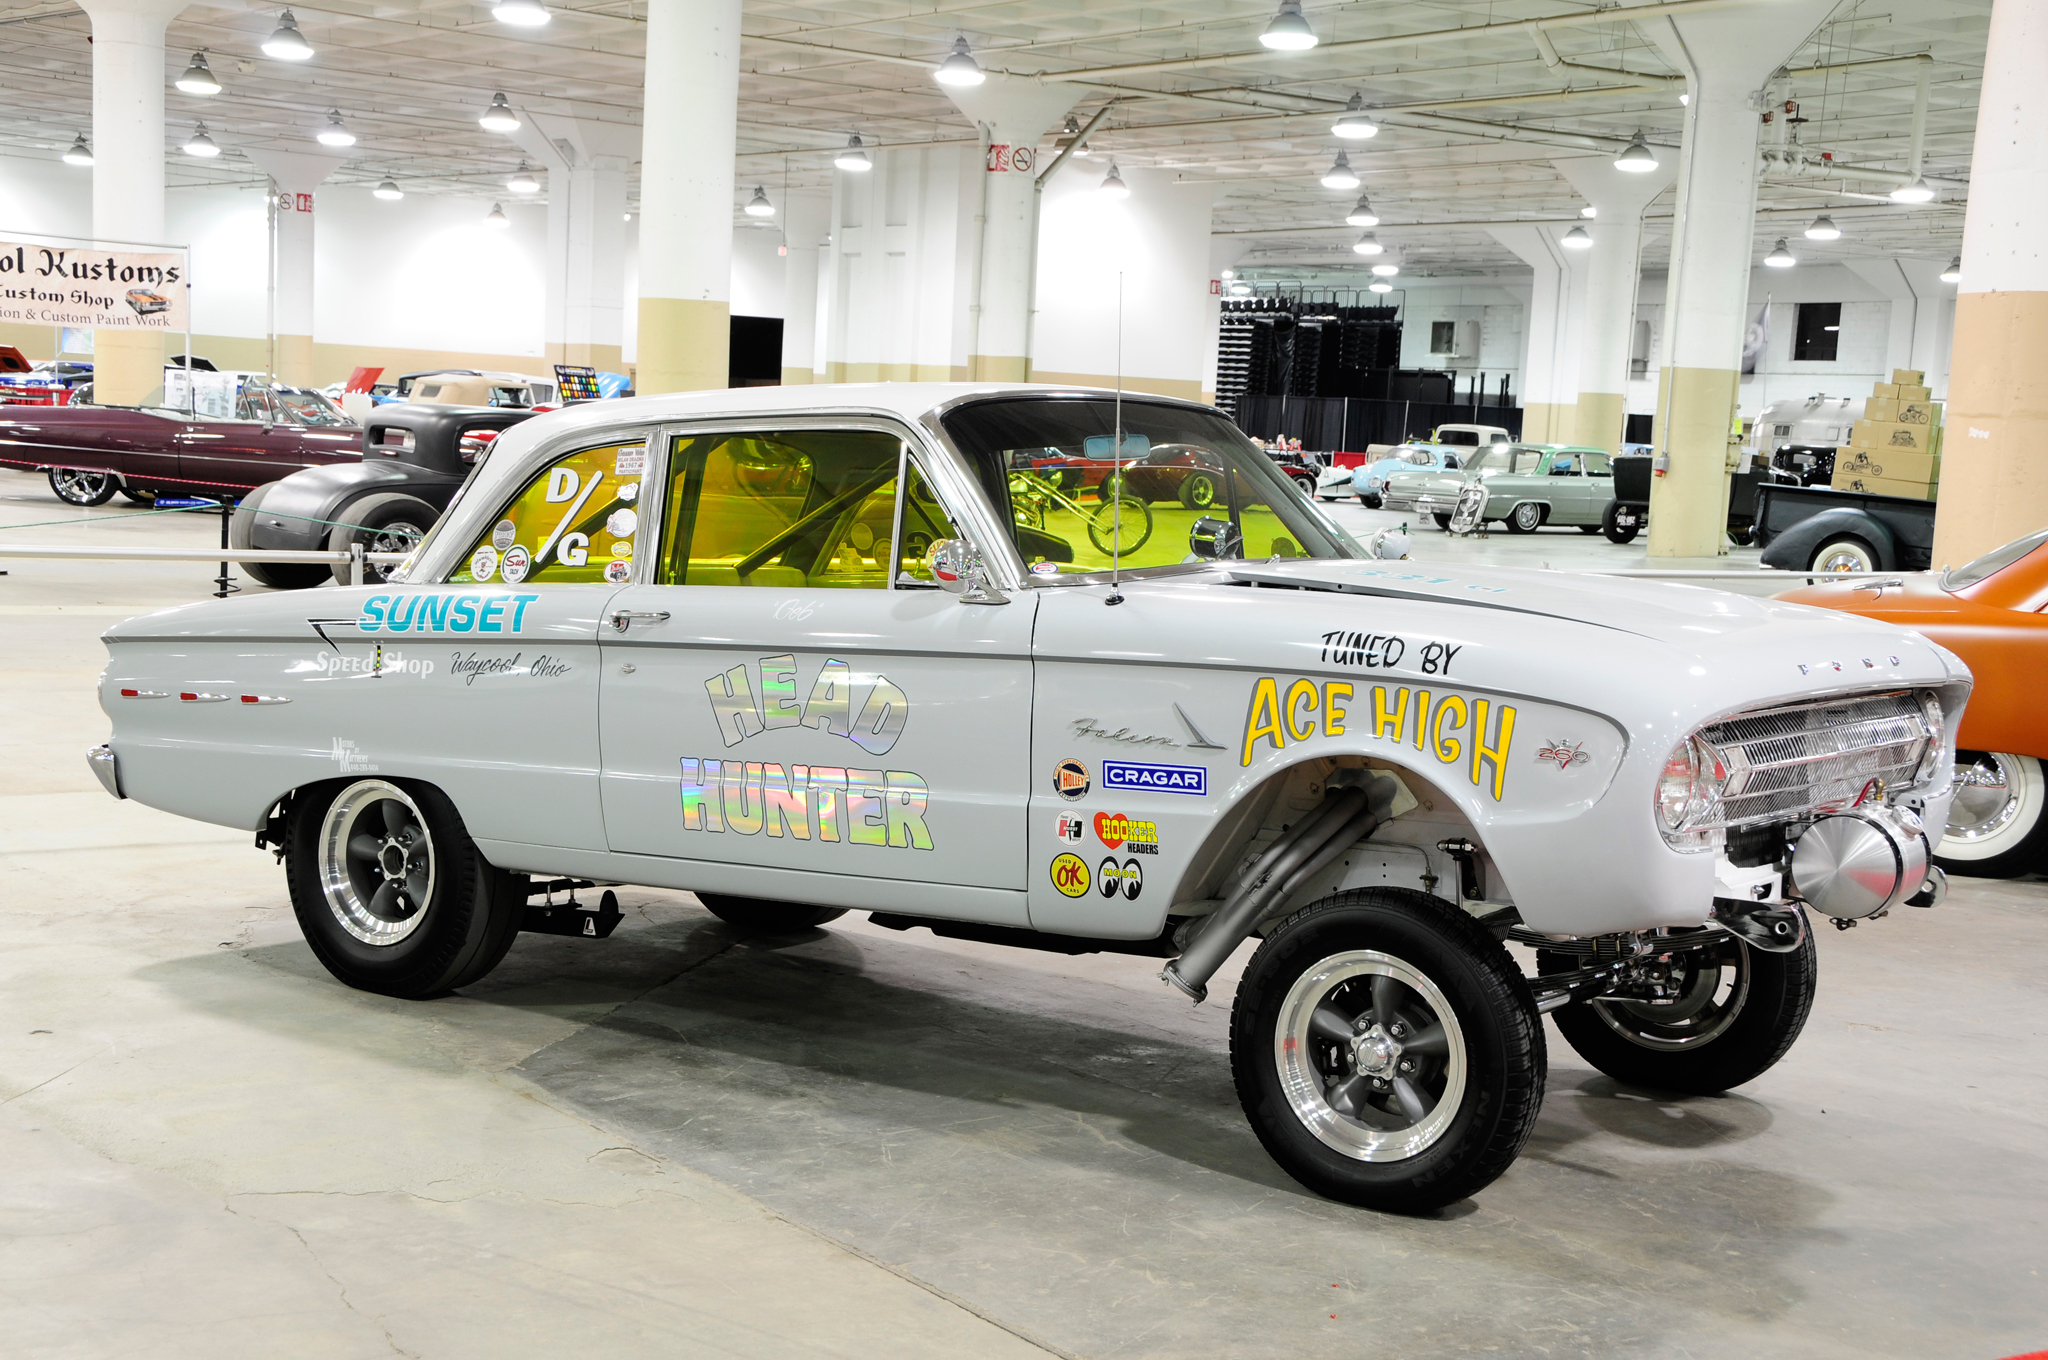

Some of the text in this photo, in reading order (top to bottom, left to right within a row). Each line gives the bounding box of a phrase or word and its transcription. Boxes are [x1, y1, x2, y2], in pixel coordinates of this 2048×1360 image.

[35, 249, 180, 288] Kustoms
[71, 290, 114, 309] Shop
[25, 308, 36, 320] &
[41, 309, 92, 324] Custom
[97, 315, 131, 326] Paint
[135, 315, 171, 327] Work
[505, 554, 527, 567] Sun
[357, 593, 542, 634] SUNSET
[382, 650, 435, 680] Shop
[1321, 630, 1463, 675] TUNED BY
[530, 654, 572, 678] Ohio
[704, 653, 909, 756] HEAD
[1072, 717, 1182, 748] Falcon
[1239, 676, 1517, 803] ACE HIGH
[1538, 747, 1590, 763] 260
[1062, 772, 1084, 788] HOLLEY
[1109, 768, 1200, 788] CRAGAR
[680, 757, 934, 851] HUNTER
[1101, 818, 1159, 844] HOOKER
[1127, 842, 1159, 855] HEADERS
[1056, 861, 1085, 888] OK
[1104, 868, 1137, 879] MOON
